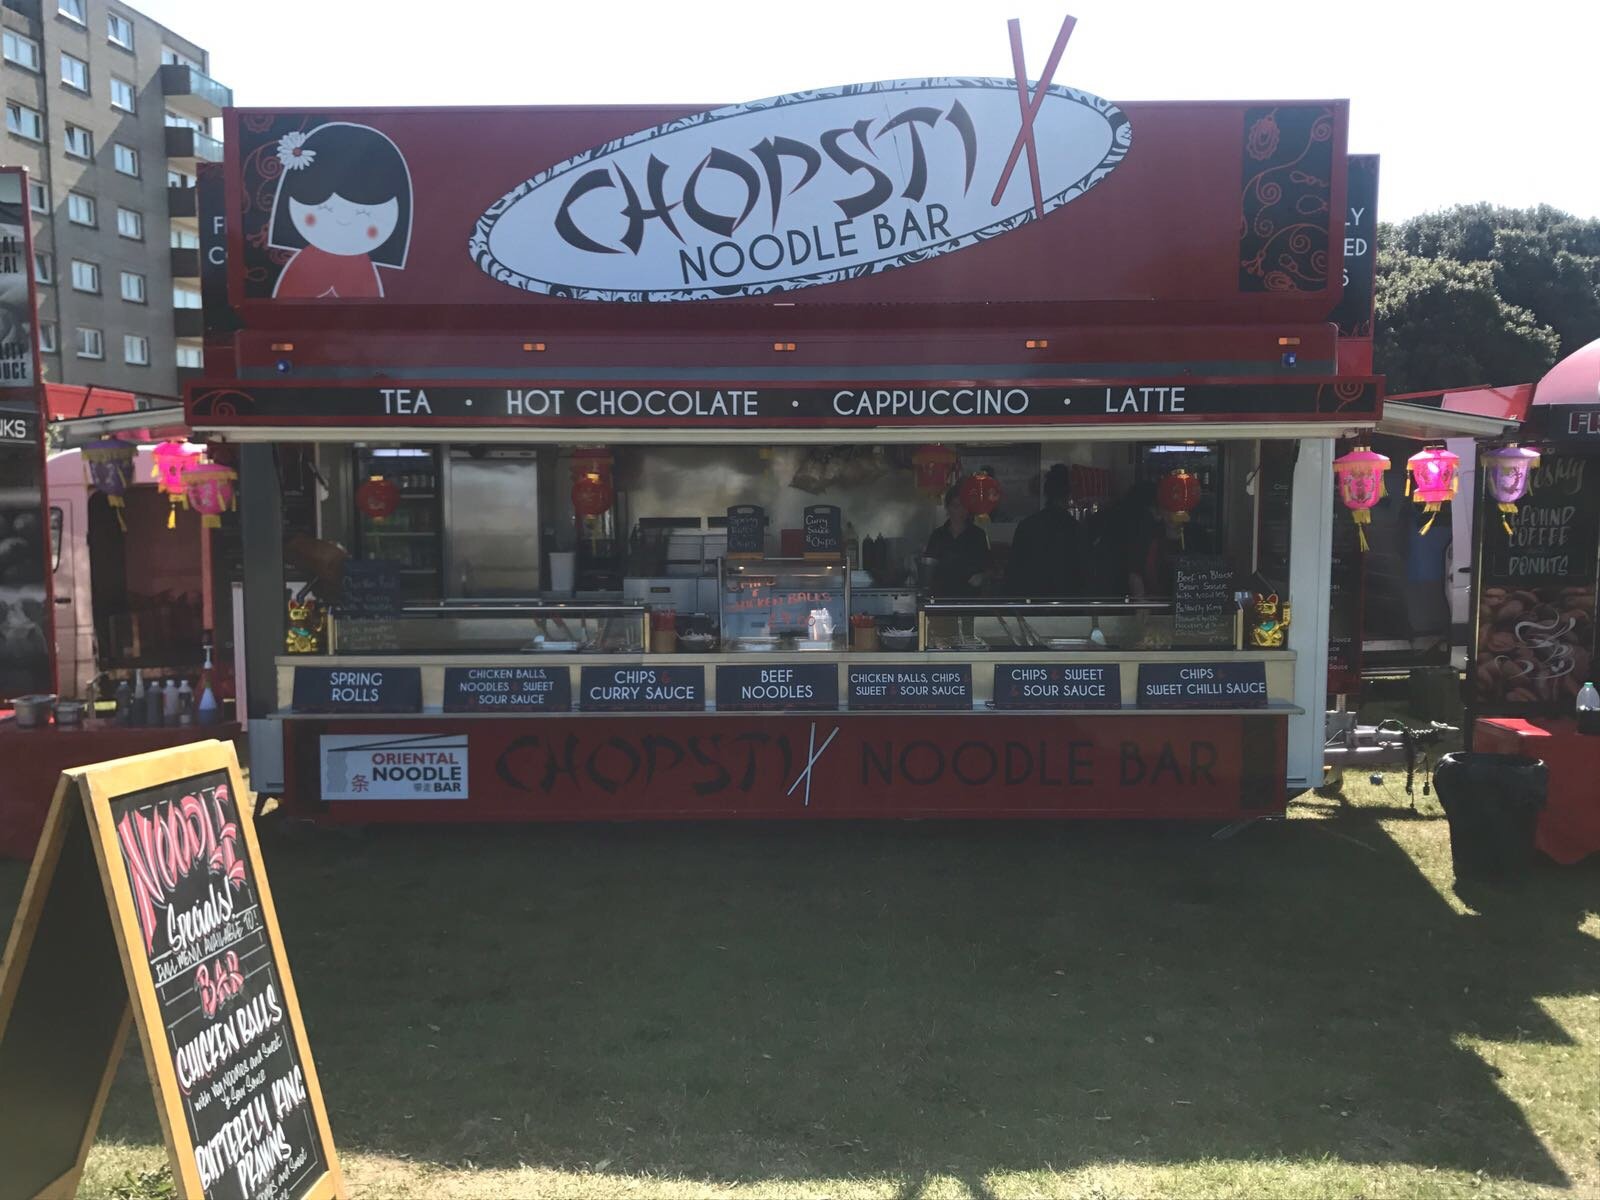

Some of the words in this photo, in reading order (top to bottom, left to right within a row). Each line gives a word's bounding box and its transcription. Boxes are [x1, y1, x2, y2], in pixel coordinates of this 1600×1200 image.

[680, 220, 859, 285] NOODLE
[876, 203, 950, 249] BAR
[380, 389, 432, 414] TEA
[507, 390, 565, 416] HOT
[576, 390, 758, 416] CHOCOLATE
[833, 389, 1029, 416] CAPPUCCINO
[1106, 387, 1186, 413] LATTE
[805, 514, 828, 527] Curry
[1509, 555, 1569, 577] DONUTS
[330, 672, 383, 685] SPRING
[468, 669, 513, 679] CHICKEN
[614, 671, 656, 684] CHIPS
[761, 670, 793, 683] BEEF
[850, 673, 894, 683] CHICKEN
[931, 673, 960, 683] CHIPS
[1011, 669, 1047, 681] CHIPS
[1064, 669, 1104, 681] SWEET
[1180, 669, 1214, 680] CHIPS
[460, 682, 510, 692] NOODLES
[523, 681, 554, 691] SWEET
[742, 685, 813, 699] NOODLES
[856, 686, 887, 696] SWEET
[900, 686, 929, 696] SOUR
[931, 686, 966, 696] SAUCE
[1023, 685, 1059, 697] SOUR
[1063, 684, 1106, 697] SAUCE
[1146, 684, 1183, 696] SWEET
[1187, 683, 1222, 695] CHILLI
[1226, 682, 1266, 694] SAUCE
[332, 688, 379, 702] ROLLS
[478, 695, 507, 704] SOUR
[510, 695, 545, 704] SAUCE
[590, 687, 640, 700] CURRY
[645, 687, 694, 700] SAUCE
[372, 752, 459, 765] ORIENTAL
[861, 741, 1093, 788] NOODLE
[1120, 741, 1218, 788] BAR
[372, 767, 462, 781] NOODLE
[434, 782, 462, 792] BAR
[177, 1016, 240, 1089] CHICKEN
[236, 984, 283, 1045] BALLS
[195, 1093, 273, 1190] BUTTERFLY
[272, 1064, 306, 1119] KING
[237, 1122, 292, 1200] PRAWNS
